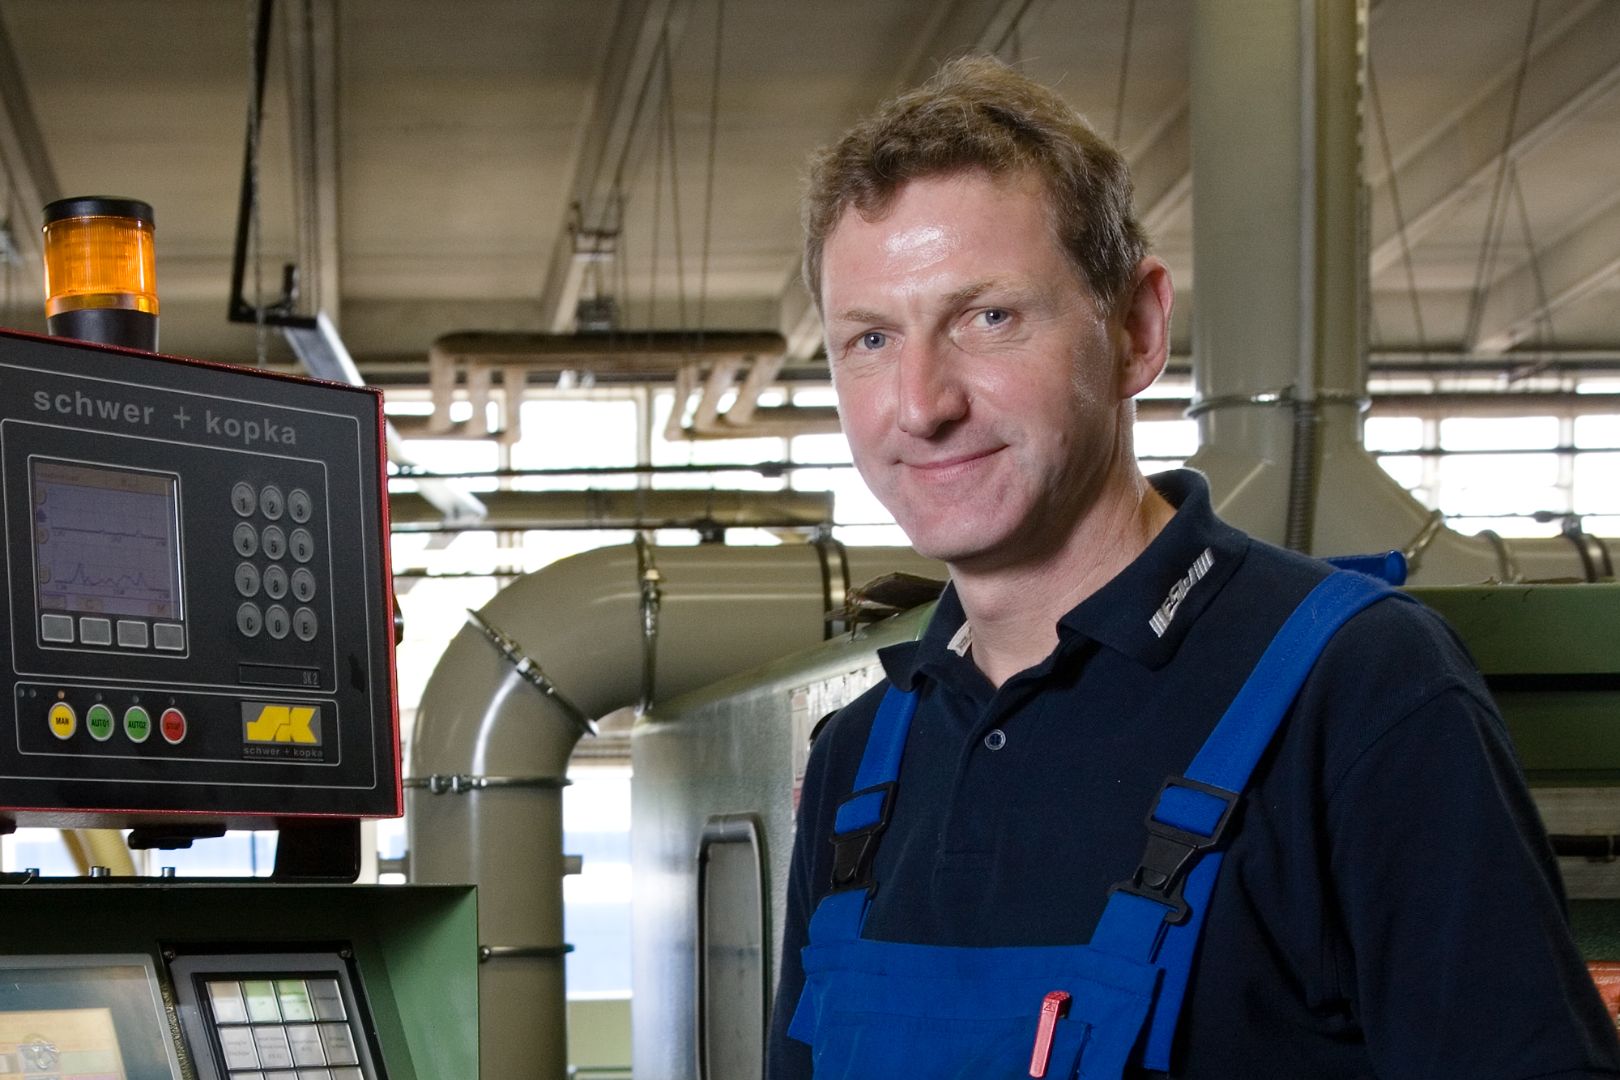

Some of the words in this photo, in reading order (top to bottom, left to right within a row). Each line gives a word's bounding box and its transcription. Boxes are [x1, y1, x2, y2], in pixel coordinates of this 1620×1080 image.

[33, 390, 154, 425] schwer
[173, 406, 191, 429] +
[206, 410, 297, 445] kopka
[55, 717, 69, 725] MAN
[91, 718, 110, 728] AUTO1
[127, 720, 147, 729] AUTO2
[243, 745, 280, 756] schwer
[293, 747, 323, 758] kopka
